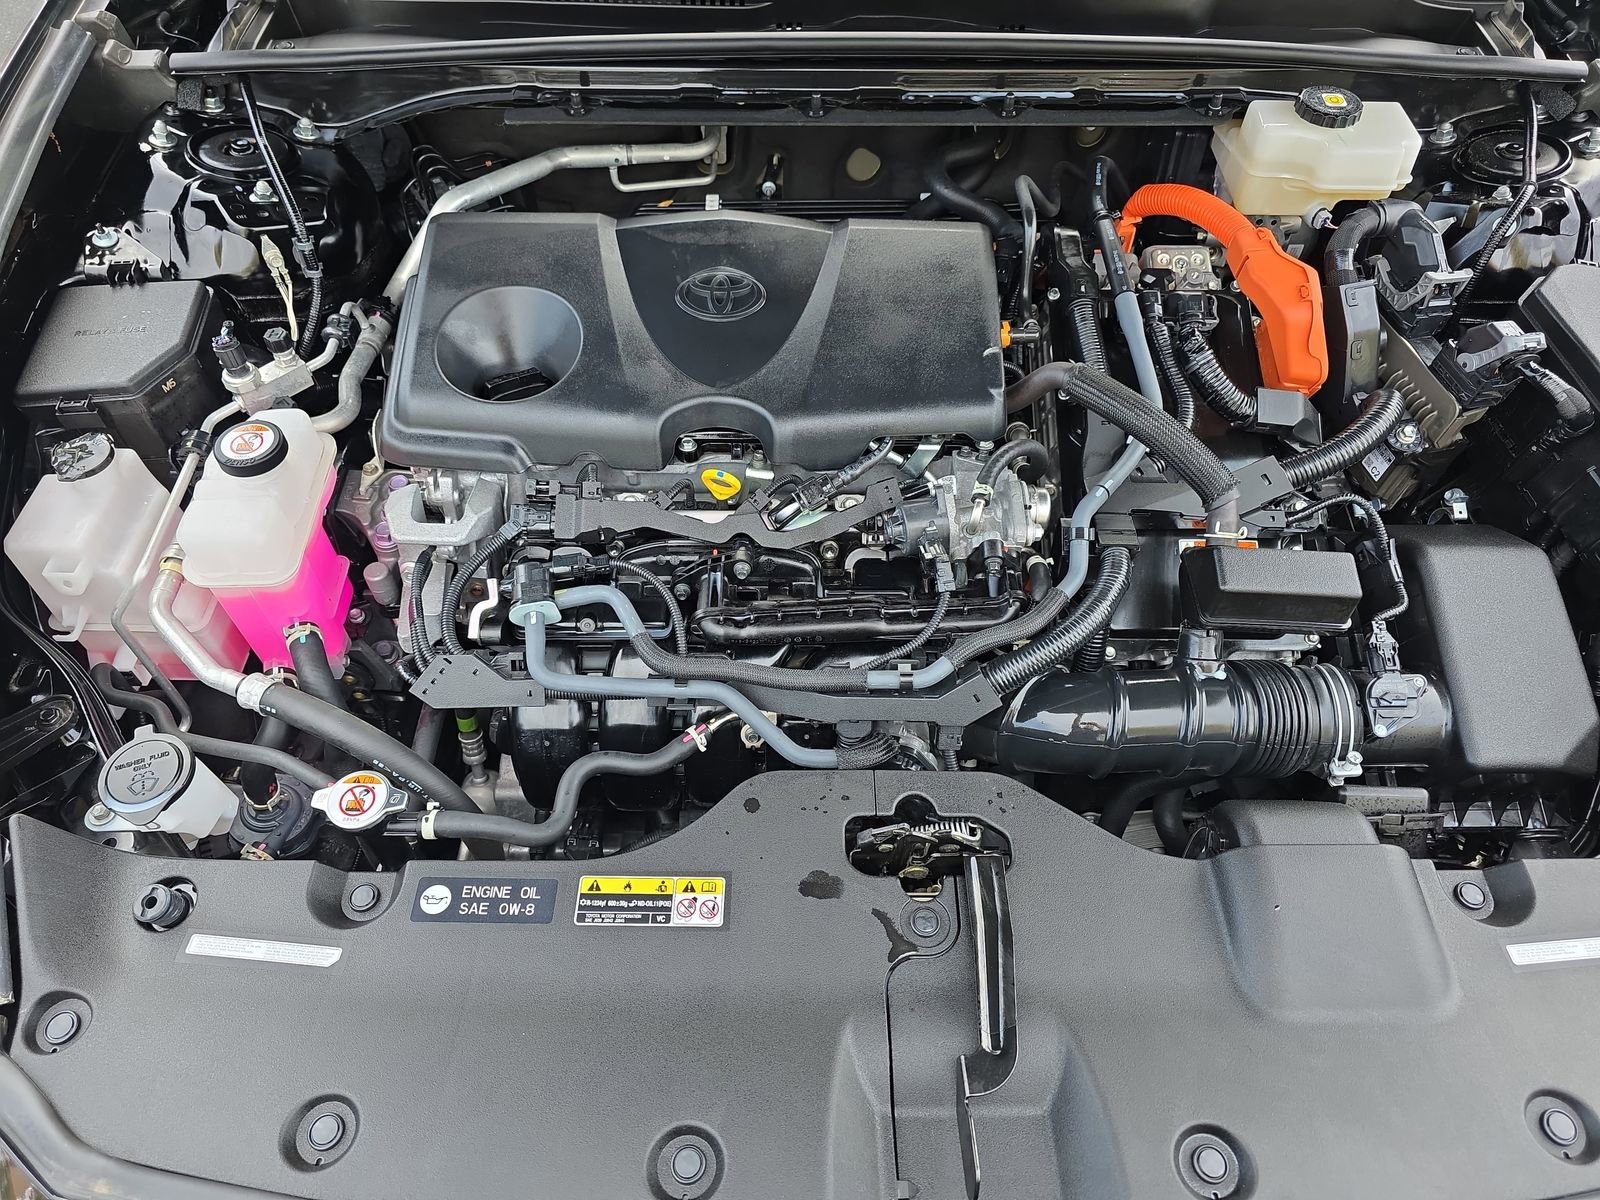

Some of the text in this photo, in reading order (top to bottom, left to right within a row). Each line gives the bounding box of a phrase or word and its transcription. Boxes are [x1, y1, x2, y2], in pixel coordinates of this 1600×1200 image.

[161, 377, 177, 393] M5
[223, 457, 256, 466] DENSO
[114, 750, 170, 771] WASHER FLUID
[133, 762, 152, 772] ONLY
[461, 885, 541, 899] ENGINE OIL
[458, 902, 535, 916] SAE 0W-8
[656, 914, 666, 923] VC
